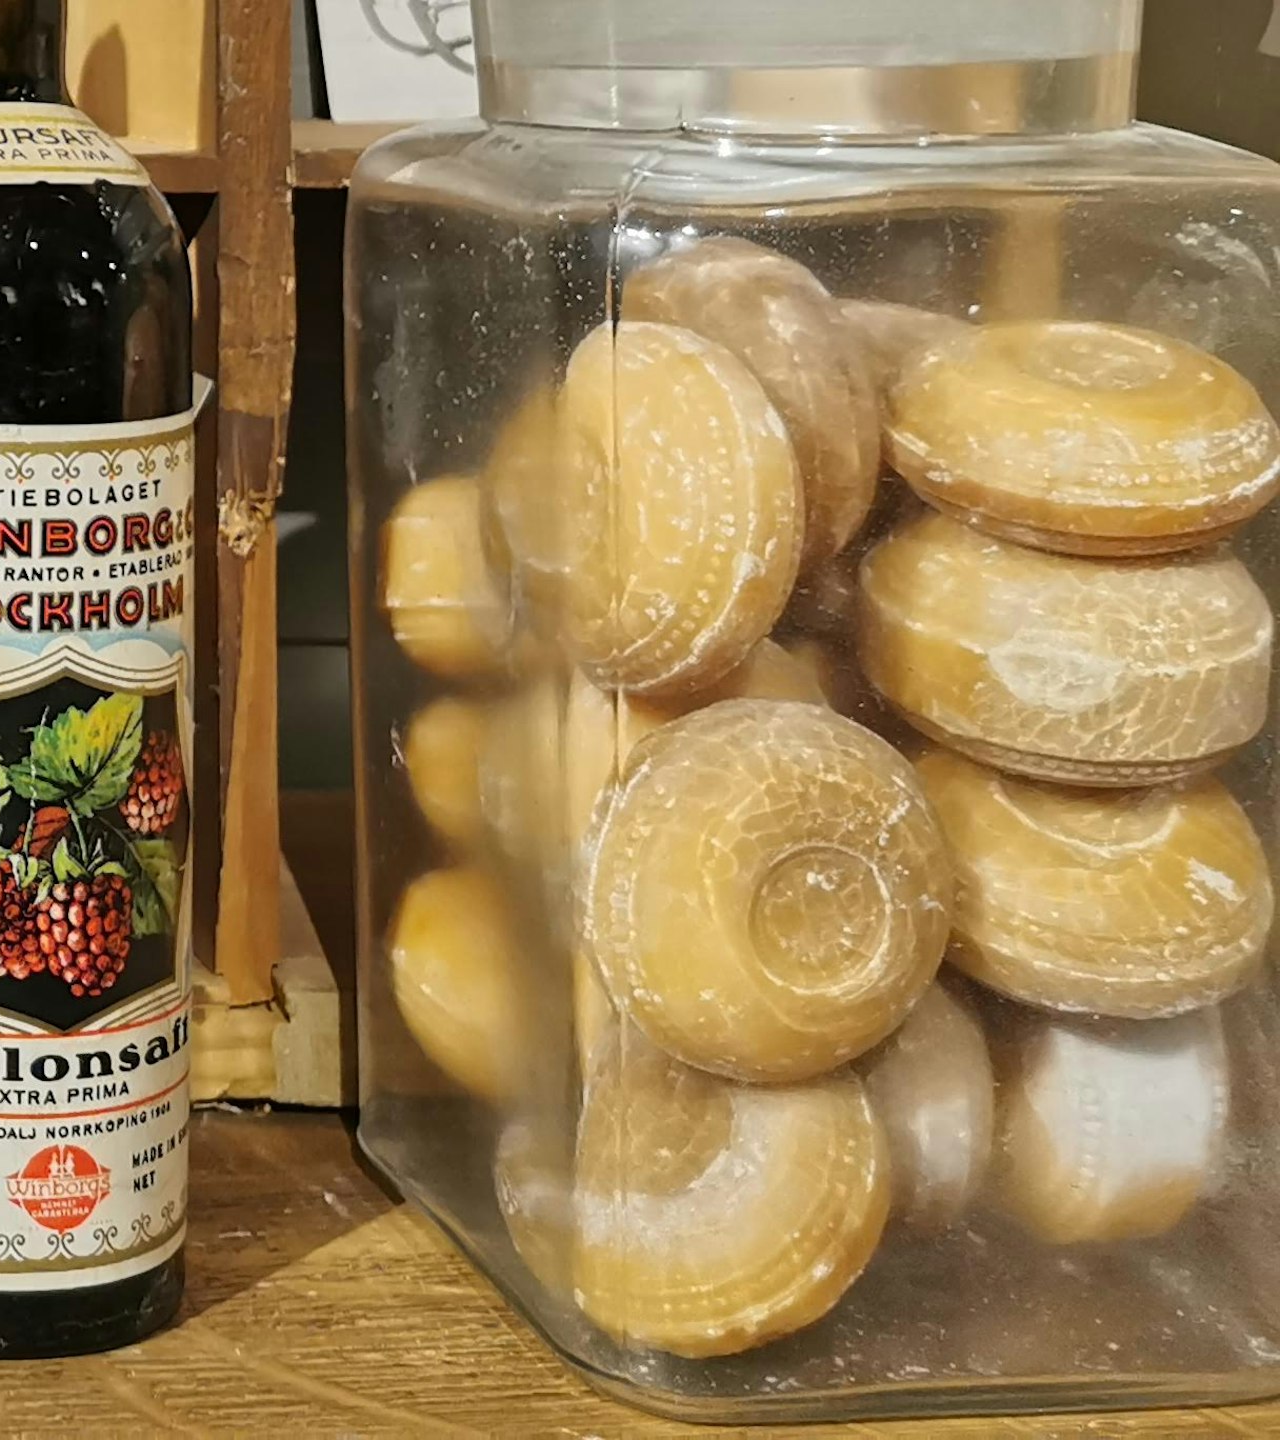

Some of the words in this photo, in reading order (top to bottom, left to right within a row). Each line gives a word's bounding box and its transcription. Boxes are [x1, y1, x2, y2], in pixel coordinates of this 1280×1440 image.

[38, 147, 116, 162] PRIMA
[109, 549, 182, 579] ETABLERAD
[67, 1081, 130, 1104] PRIMA
[132, 1143, 164, 1169] MADE
[166, 1134, 176, 1154] IN
[6, 1171, 111, 1200] Winborgs
[132, 1170, 156, 1194] NET
